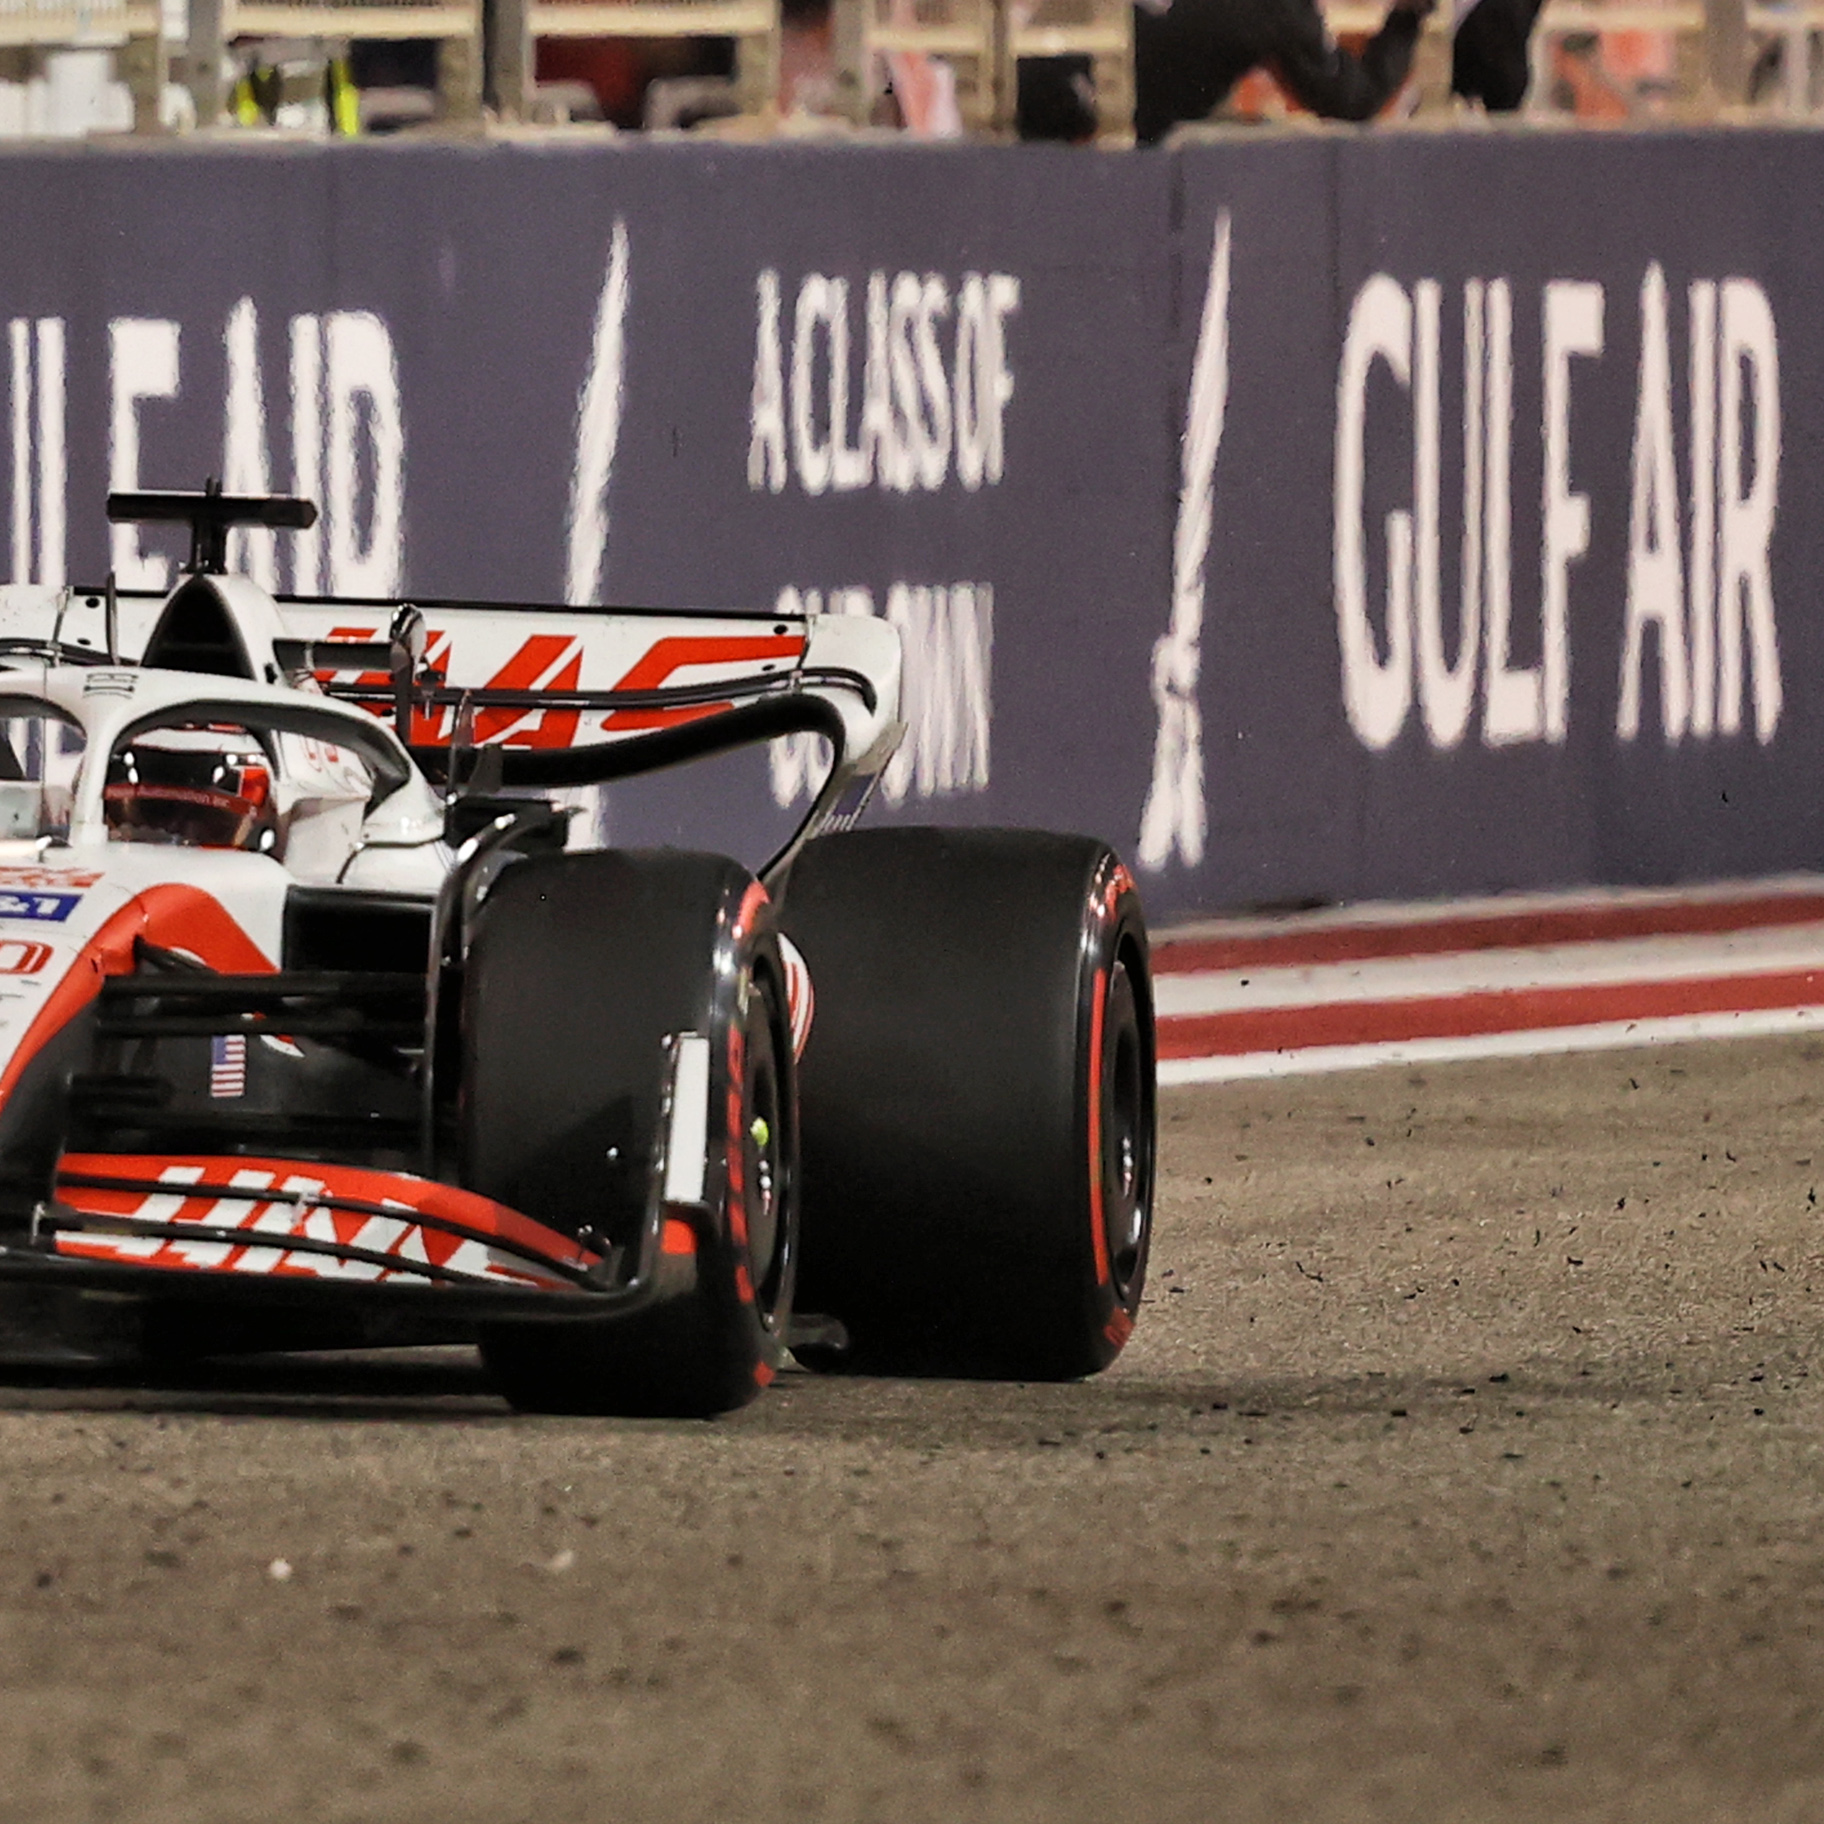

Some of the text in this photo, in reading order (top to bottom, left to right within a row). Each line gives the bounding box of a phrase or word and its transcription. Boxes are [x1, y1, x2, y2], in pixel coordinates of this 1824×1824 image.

[747, 268, 1021, 496] A CLASS OF
[1333, 260, 1783, 750] GULF AIR
